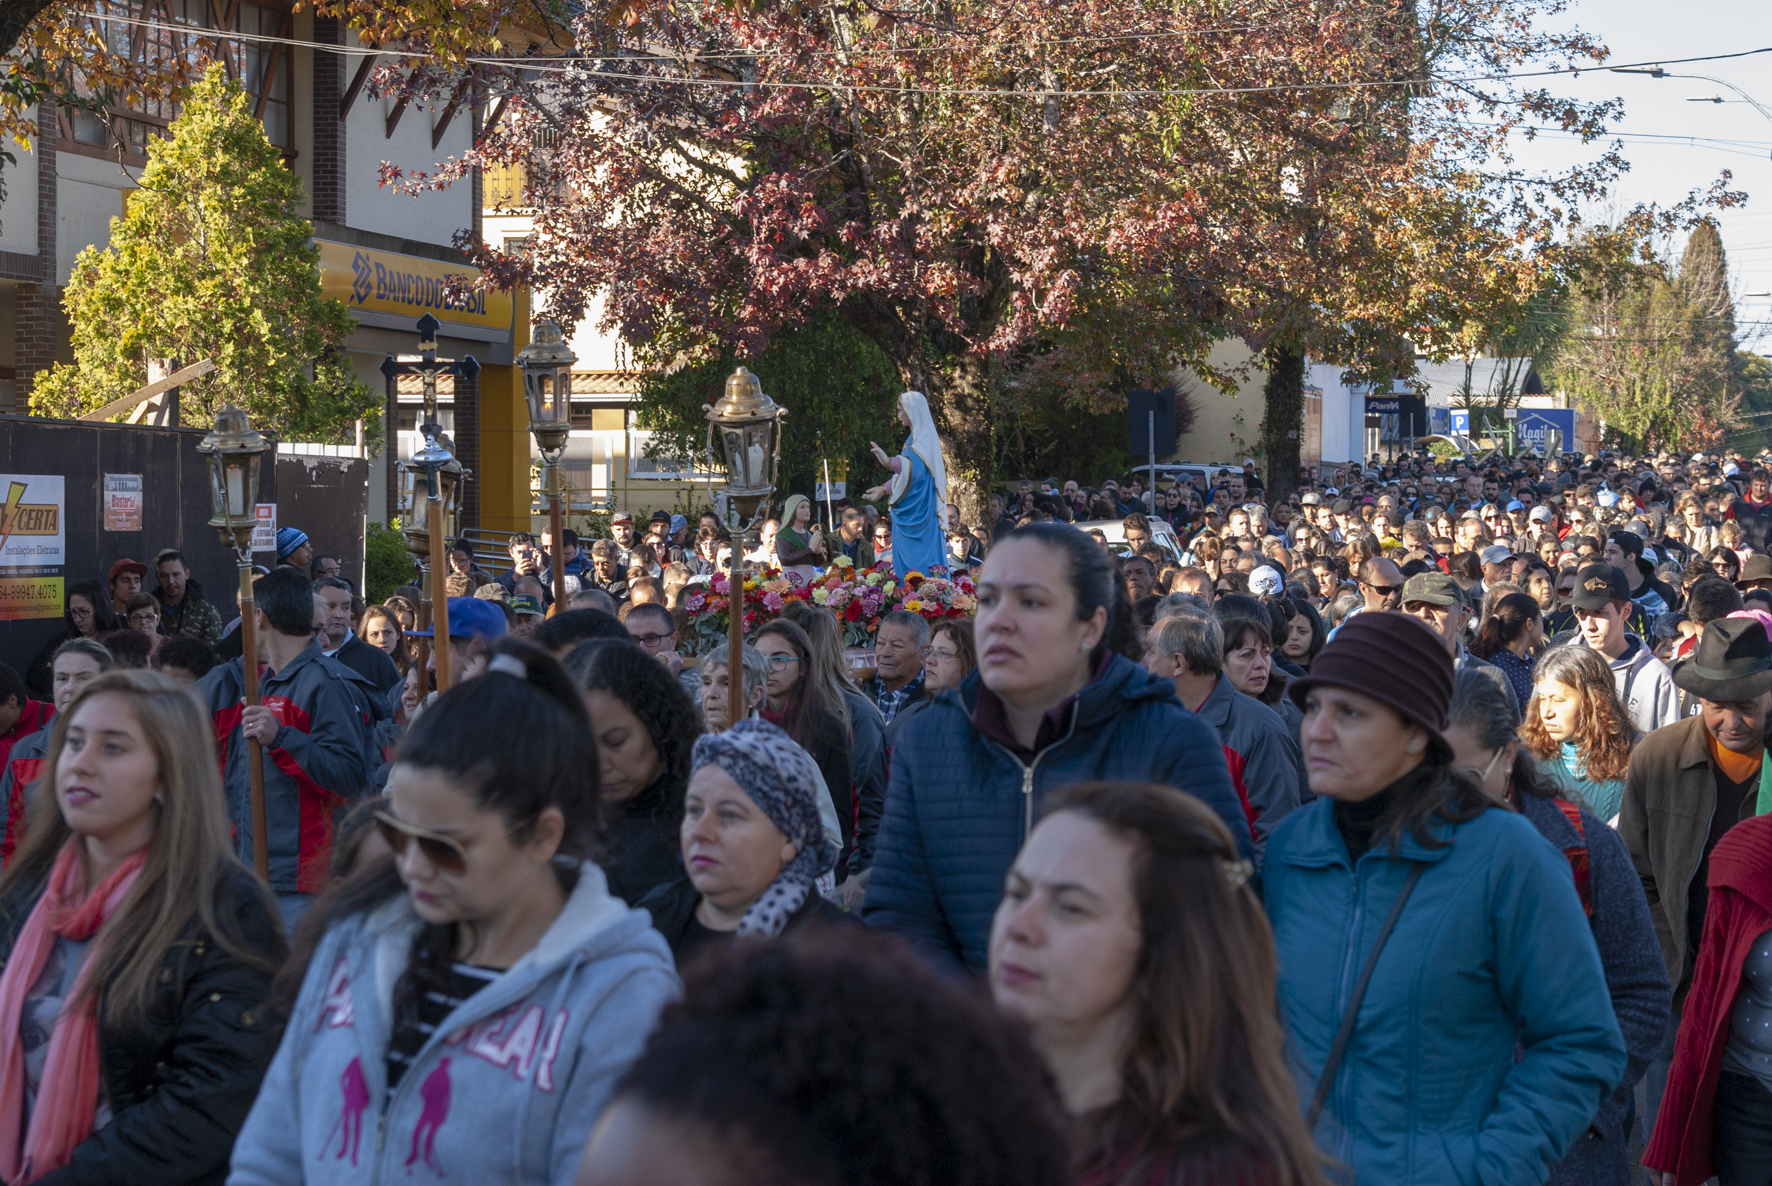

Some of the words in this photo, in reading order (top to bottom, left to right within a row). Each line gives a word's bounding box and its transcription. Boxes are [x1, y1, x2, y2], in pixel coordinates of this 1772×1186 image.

[374, 261, 425, 307] BANCO
[425, 276, 443, 309] DO
[442, 273, 487, 316] BSIL
[1368, 401, 1399, 410] PanV
[1455, 416, 1465, 429] P
[17, 508, 57, 531] CERTA
